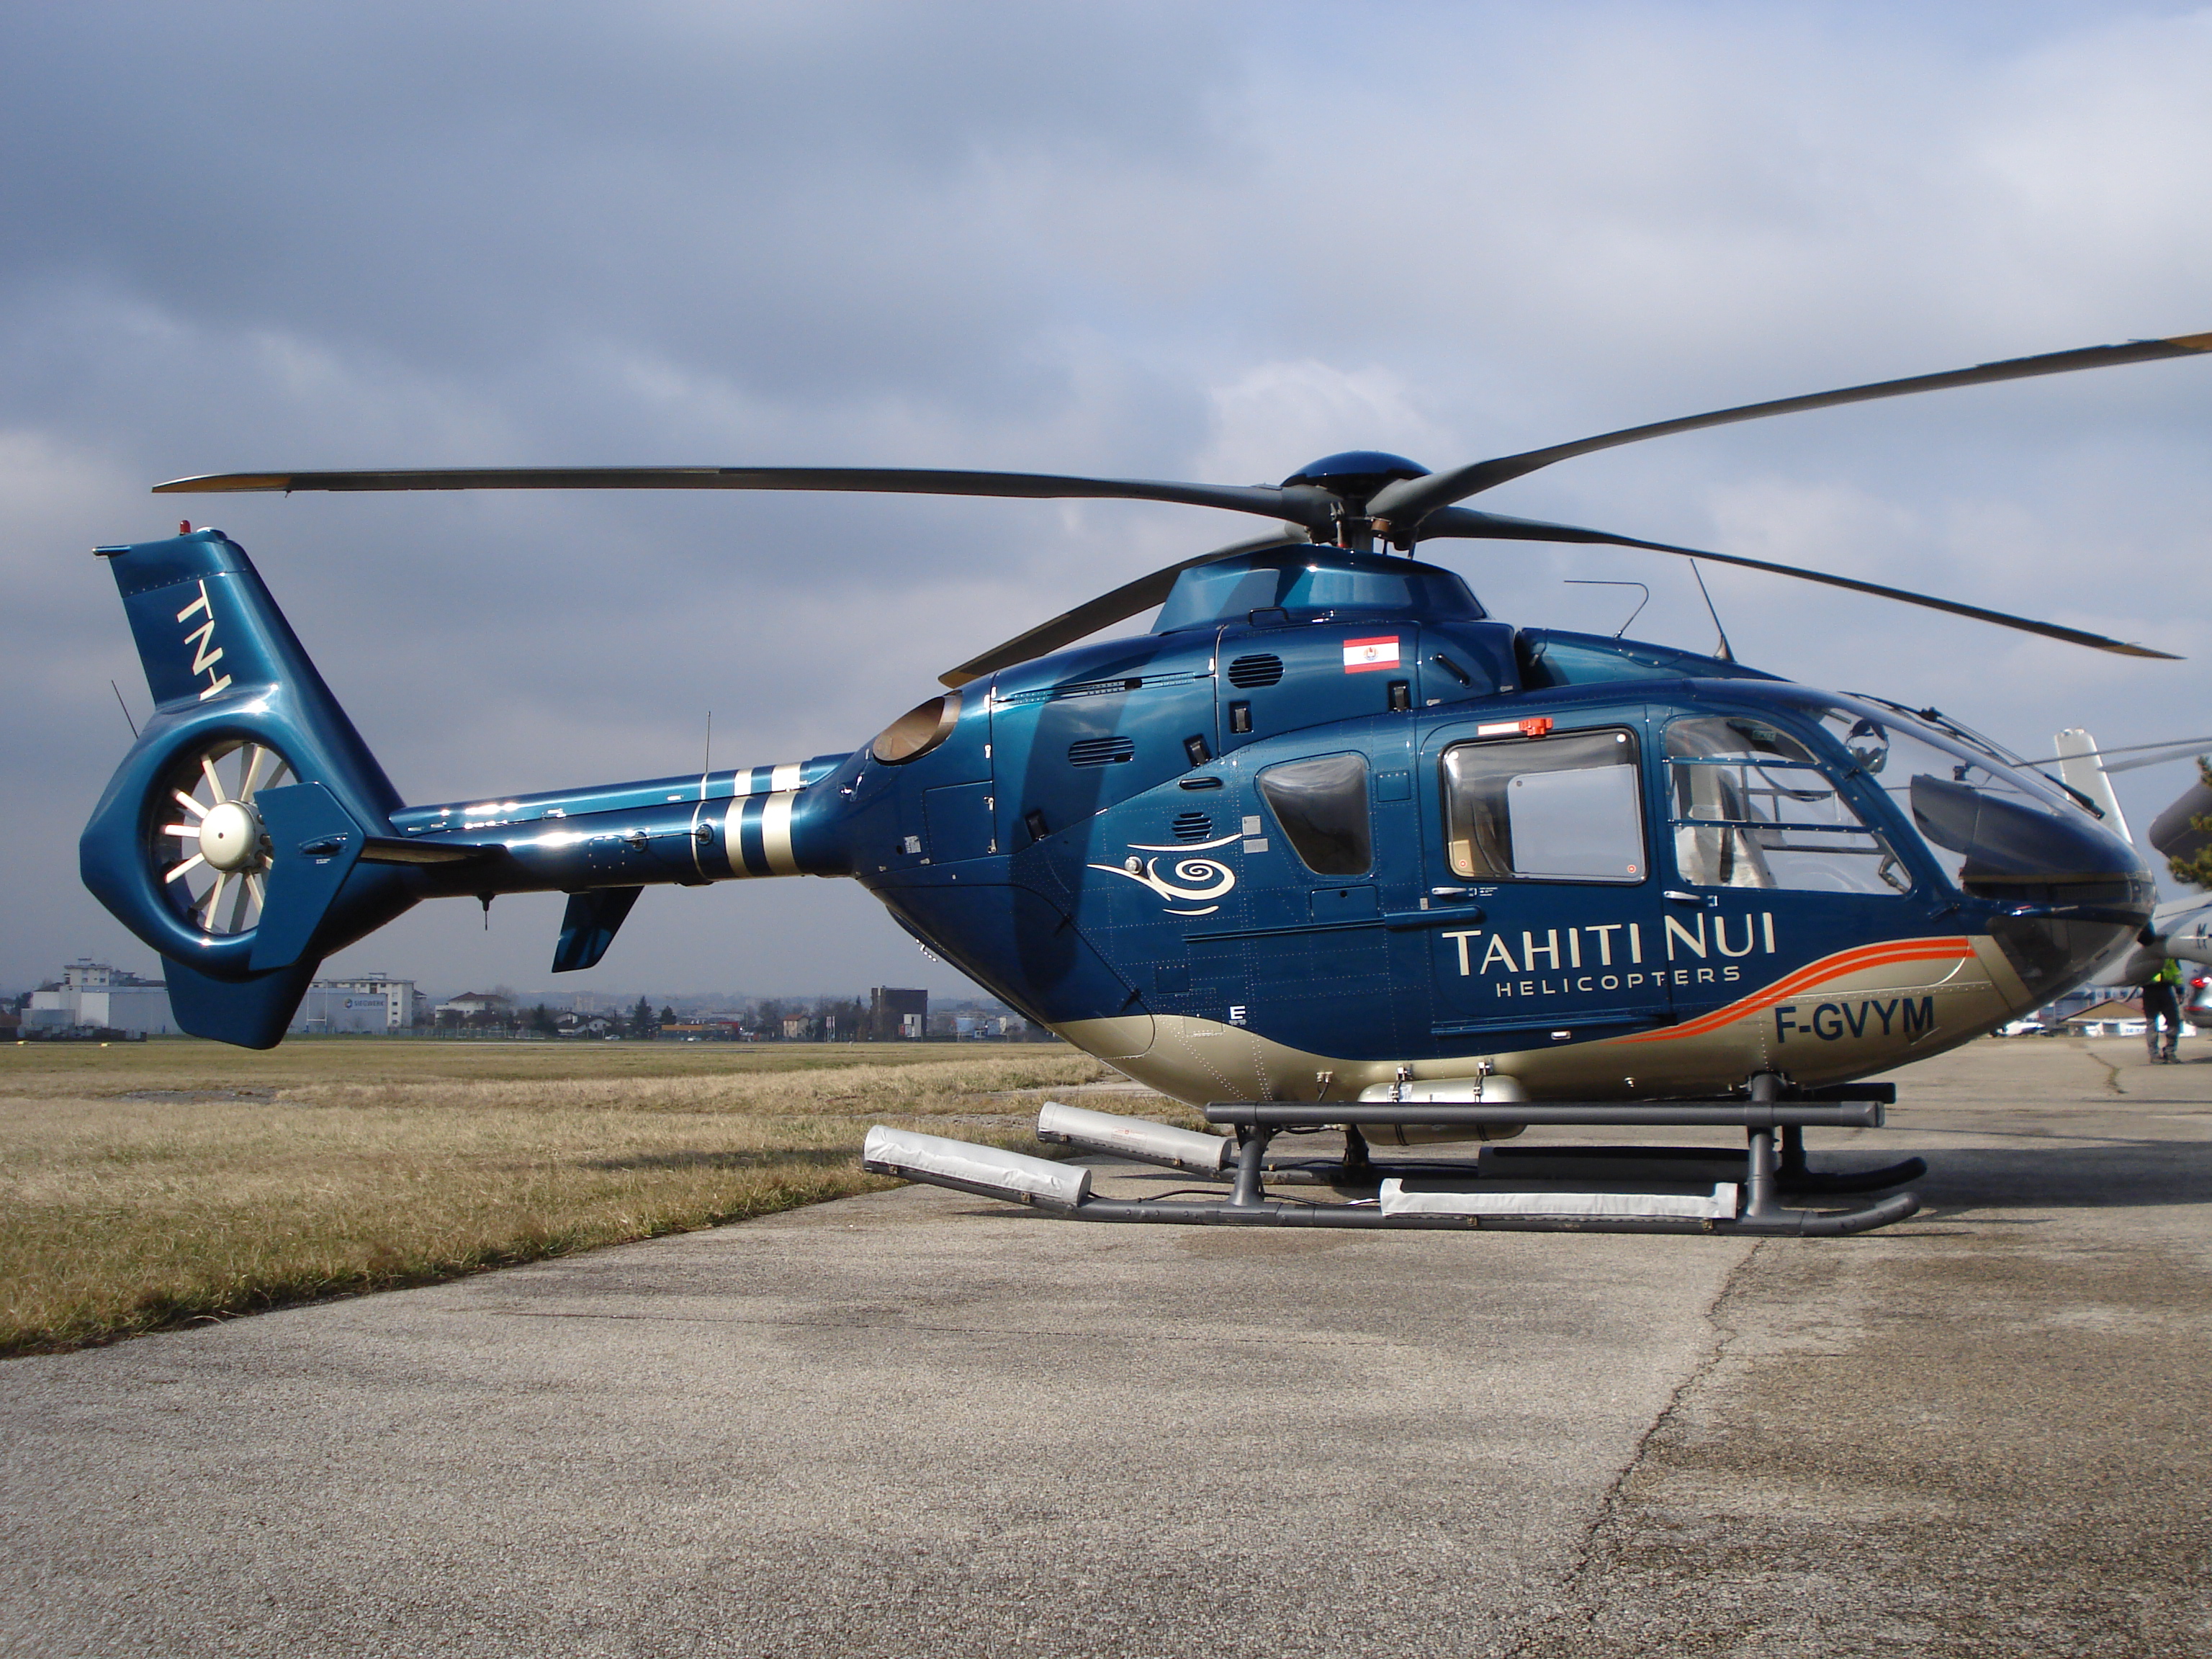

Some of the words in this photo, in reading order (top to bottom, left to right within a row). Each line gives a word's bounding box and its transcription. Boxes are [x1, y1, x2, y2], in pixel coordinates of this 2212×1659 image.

[1442, 922, 1642, 976] TAHITI
[1664, 912, 1776, 961] NUI
[1496, 966, 1741, 998] HELICOPTERS
[1229, 1005, 1246, 1020] E
[1774, 996, 1934, 1043] F-GVYM
